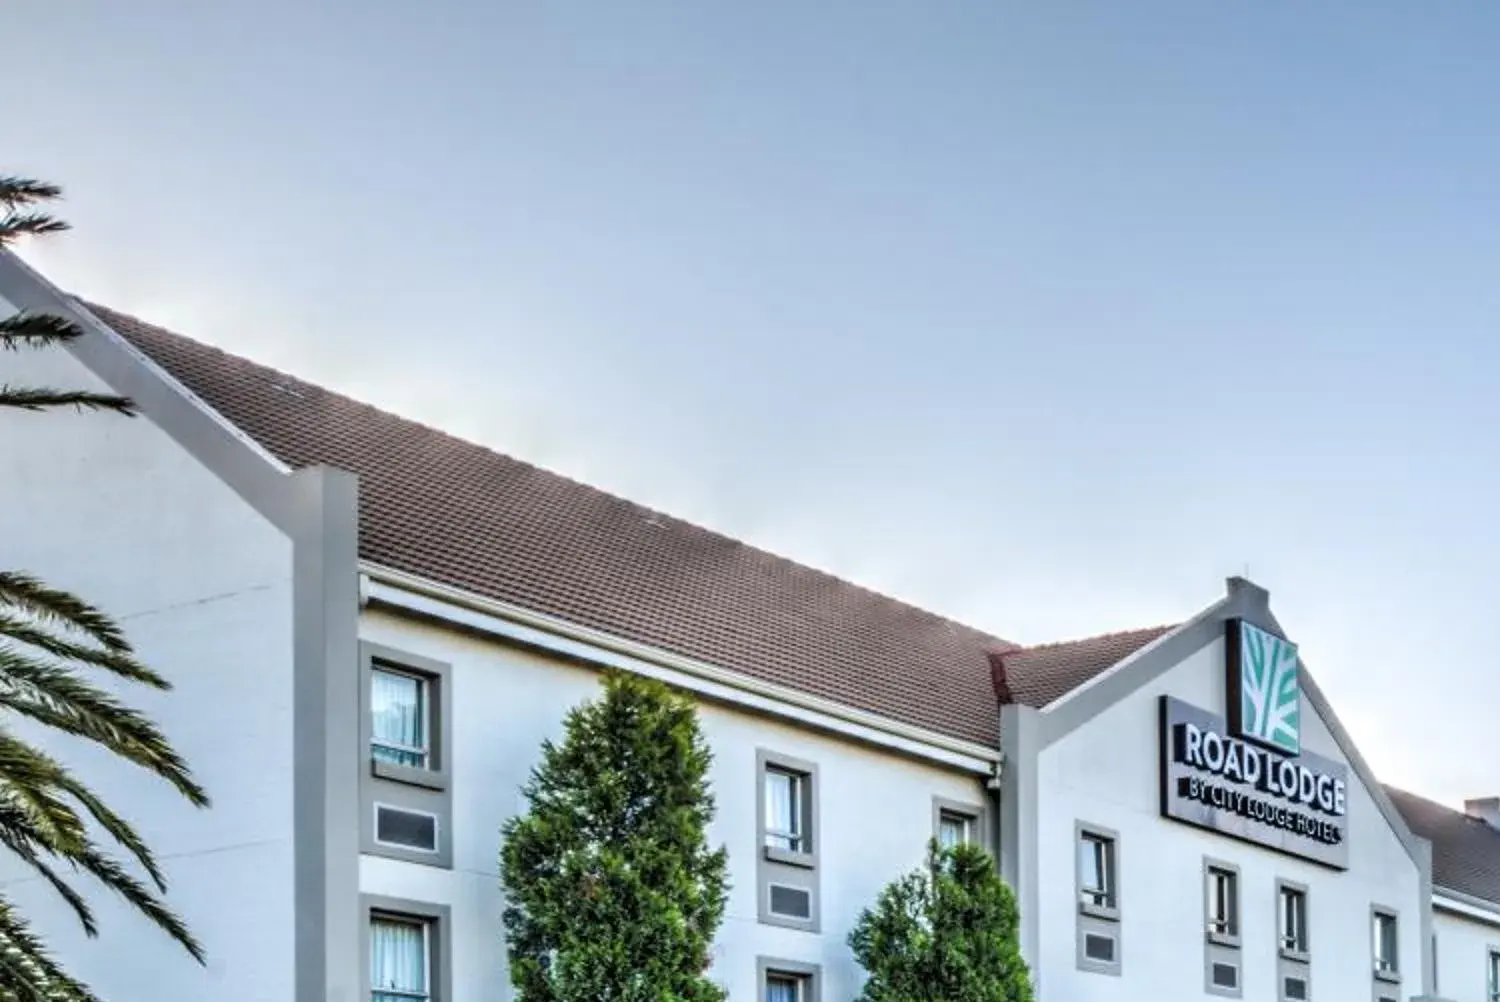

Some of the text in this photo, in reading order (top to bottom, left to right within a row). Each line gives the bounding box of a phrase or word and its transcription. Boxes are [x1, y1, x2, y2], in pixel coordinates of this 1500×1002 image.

[1185, 723, 1345, 816] ROAD LODGE
[1188, 776, 1342, 844] BY CITY LODGE HOTELS
